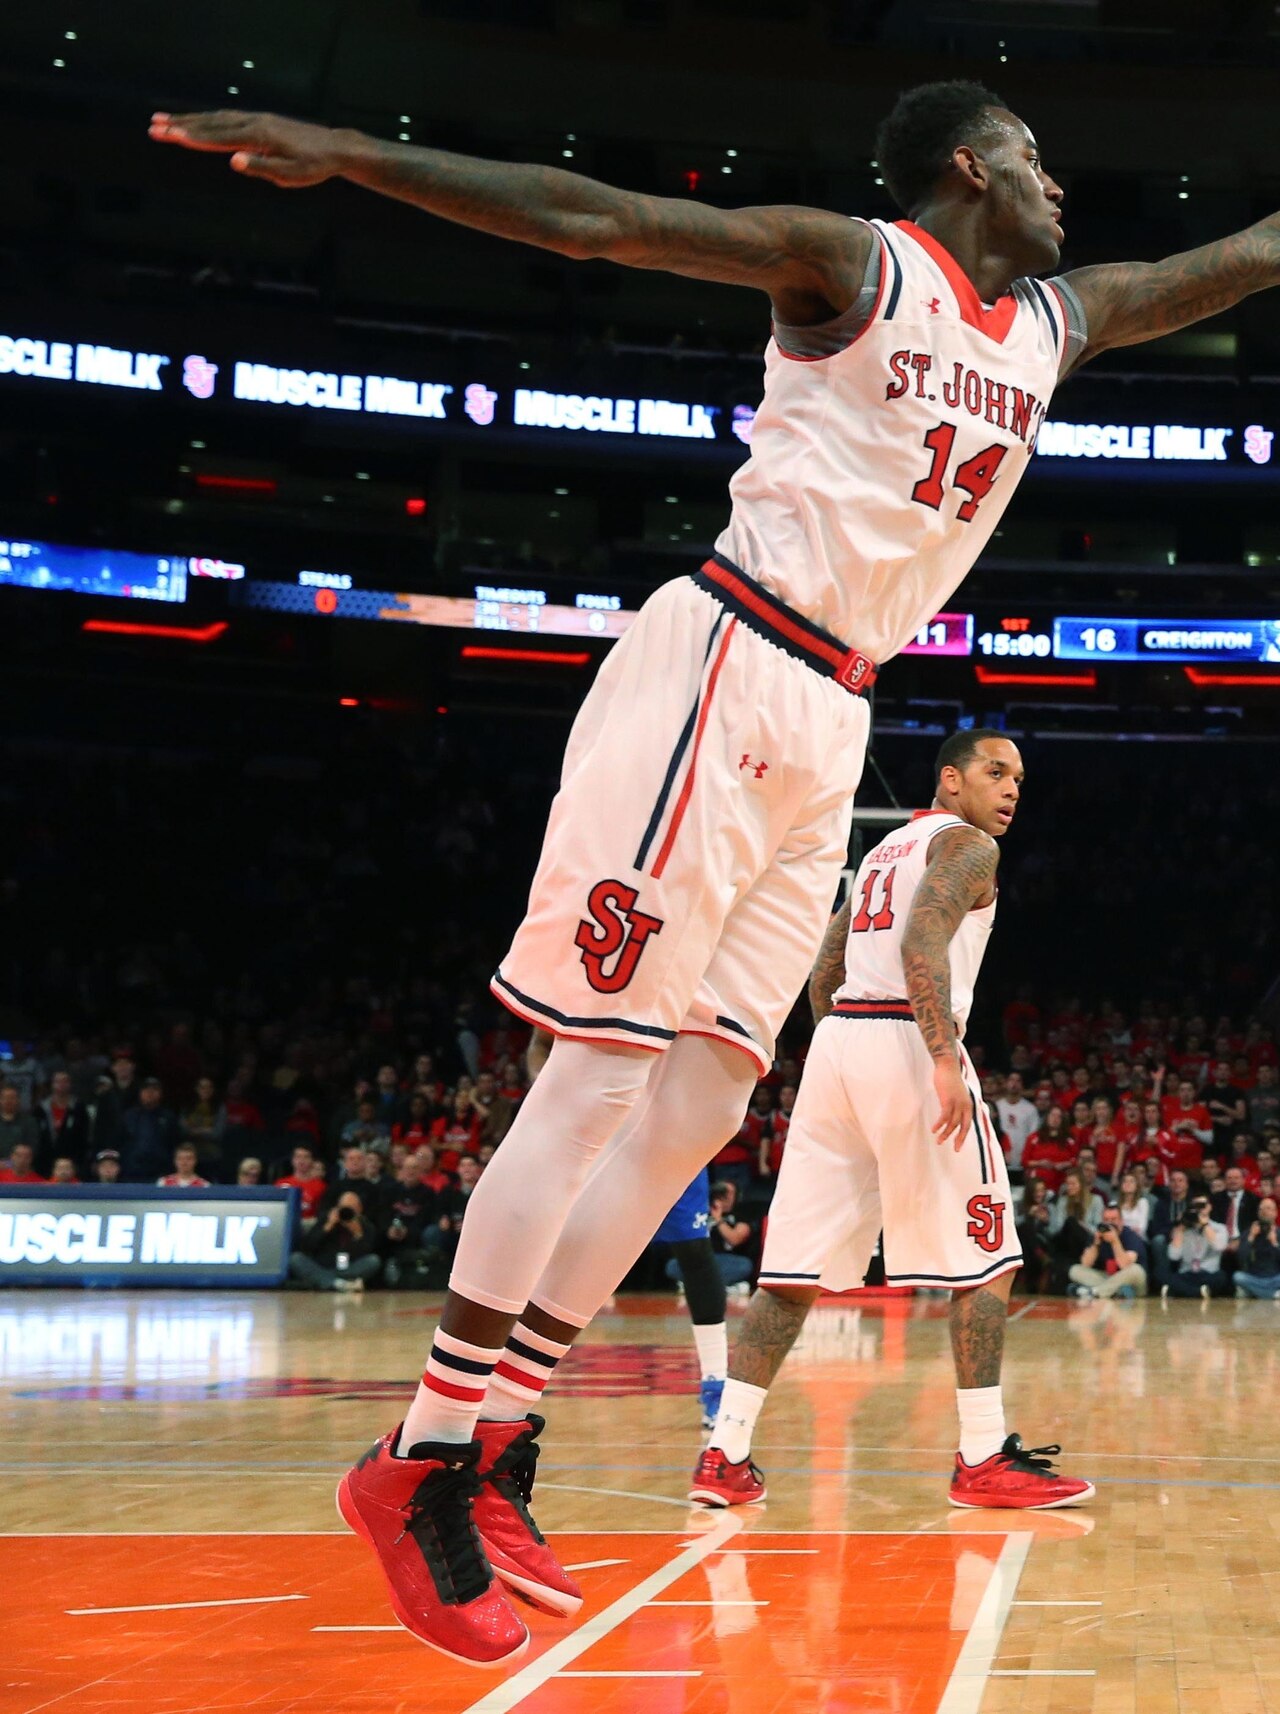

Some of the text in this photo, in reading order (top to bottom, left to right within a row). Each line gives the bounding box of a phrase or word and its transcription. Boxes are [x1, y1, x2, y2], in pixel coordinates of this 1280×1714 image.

[75, 344, 162, 391] MILK
[234, 362, 443, 418] MUSCLE MILK
[886, 350, 936, 401] ST.
[514, 389, 635, 433] MUSCLE
[638, 399, 716, 439] MILK
[1036, 421, 1227, 460] MUSCLE MILK
[911, 421, 1008, 523] 14
[914, 623, 946, 647] 11
[978, 633, 1051, 657] 15:00
[1080, 628, 1116, 652] 16
[1144, 630, 1252, 650] CREIGHTON
[852, 864, 897, 933] 11
[140, 1212, 258, 1264] MILK
